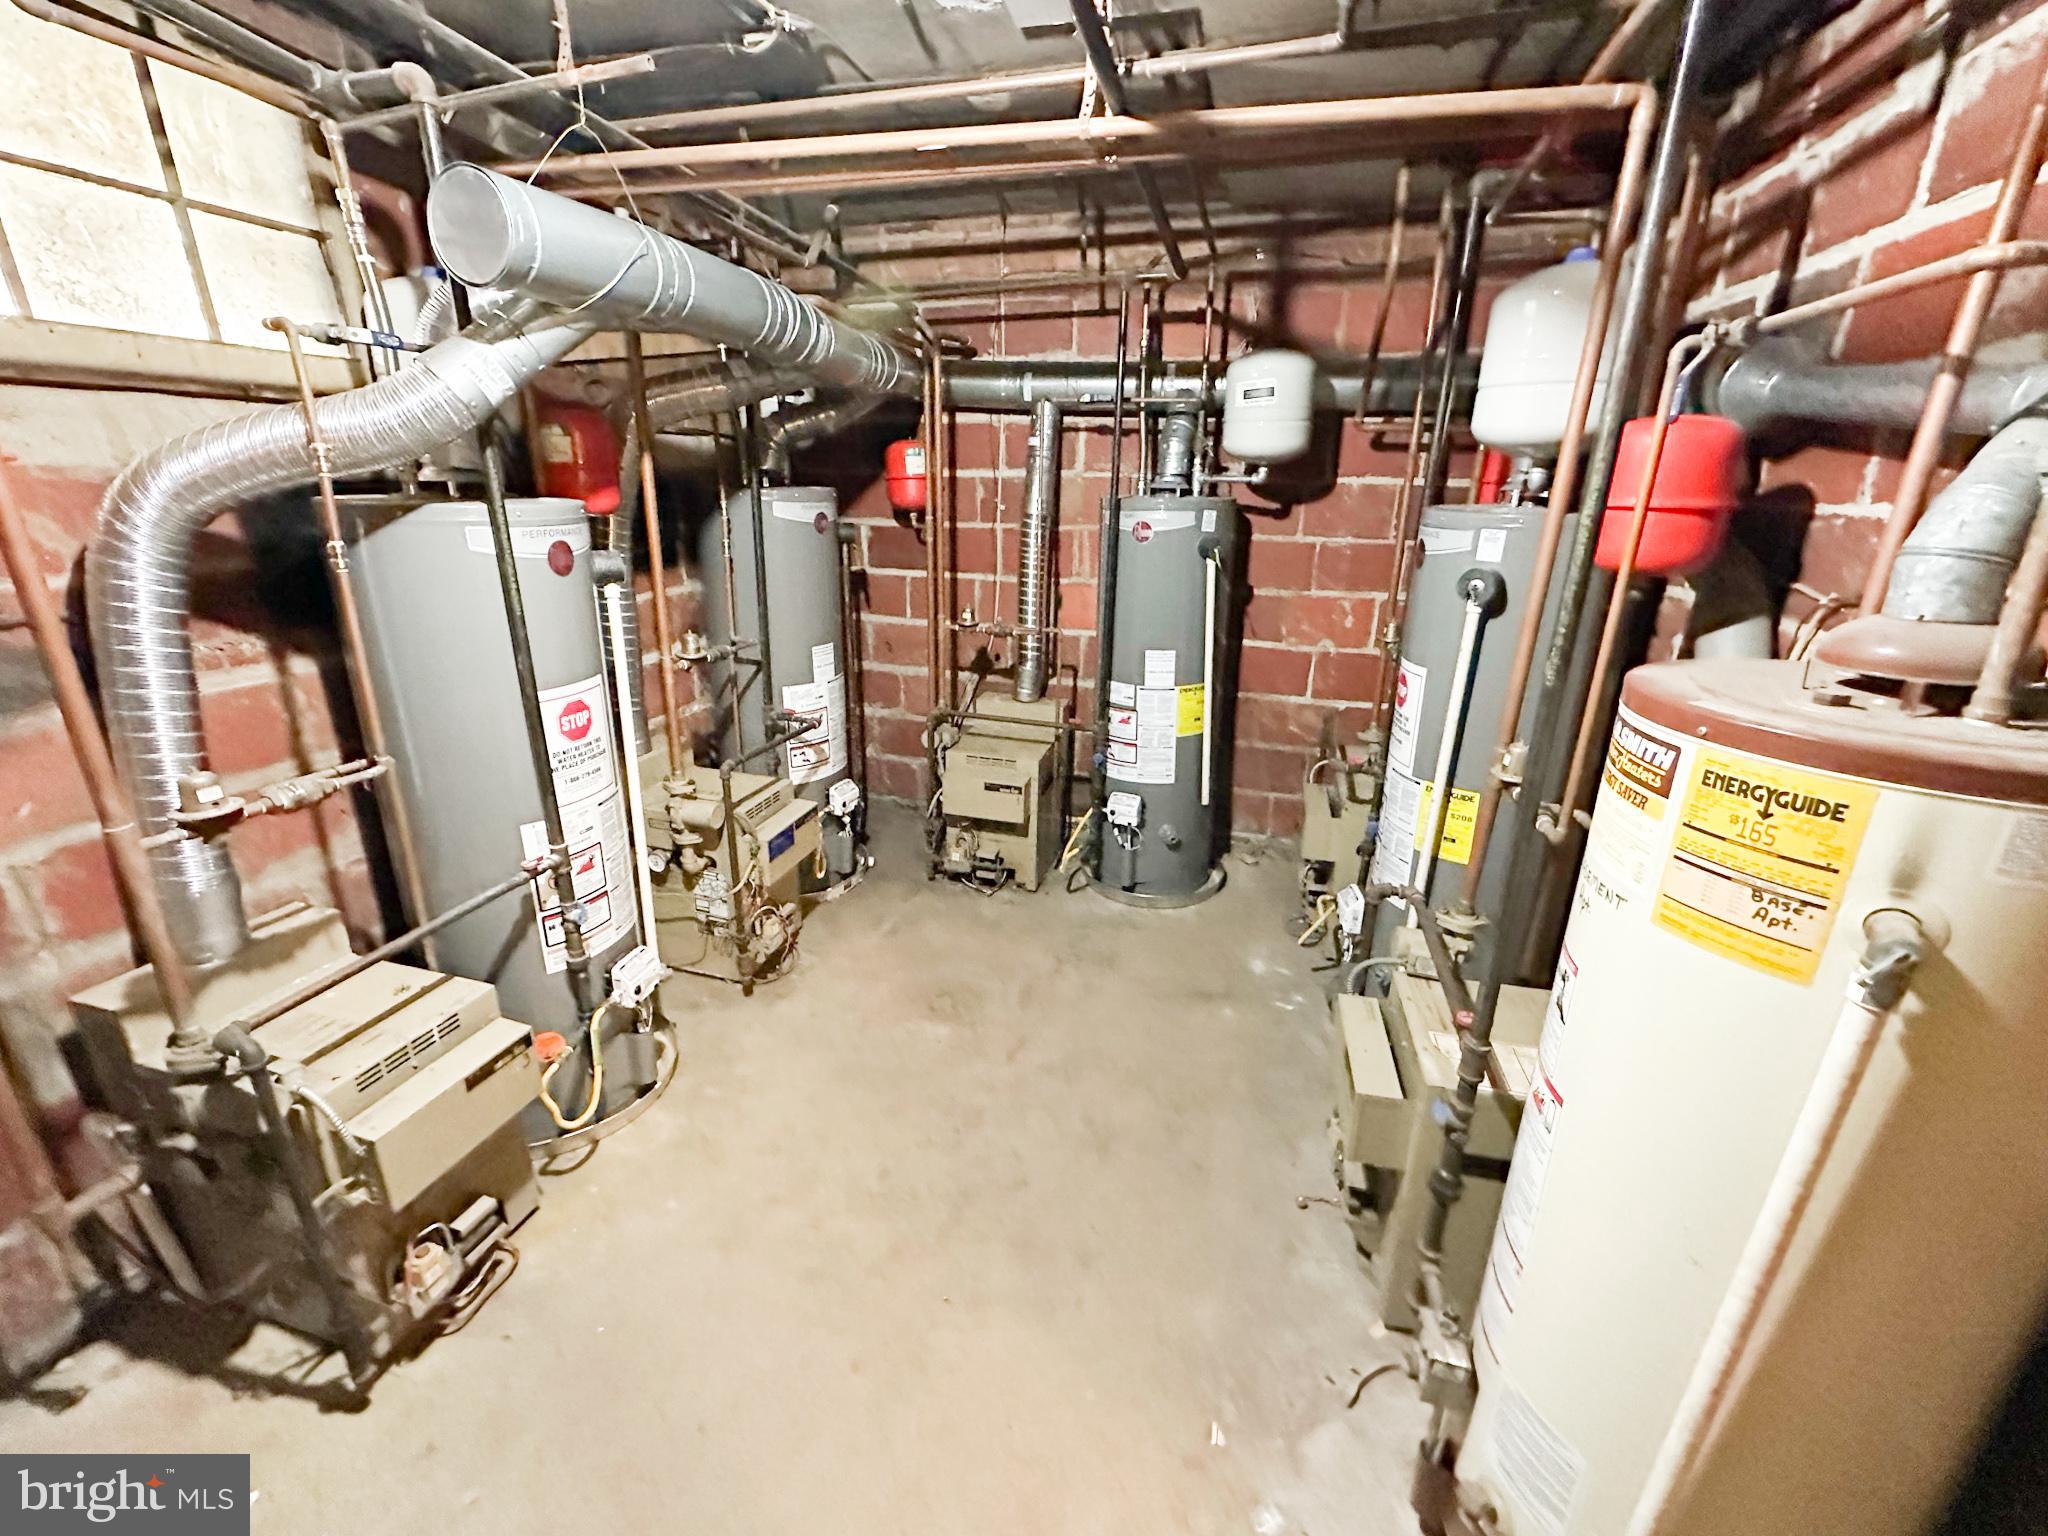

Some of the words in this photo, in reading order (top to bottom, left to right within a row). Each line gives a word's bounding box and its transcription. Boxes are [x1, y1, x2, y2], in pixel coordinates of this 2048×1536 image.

[561, 710, 590, 731] STOP
[1616, 781, 1649, 810] SAVER
[1701, 769, 1850, 823] ENERGYGUIDE
